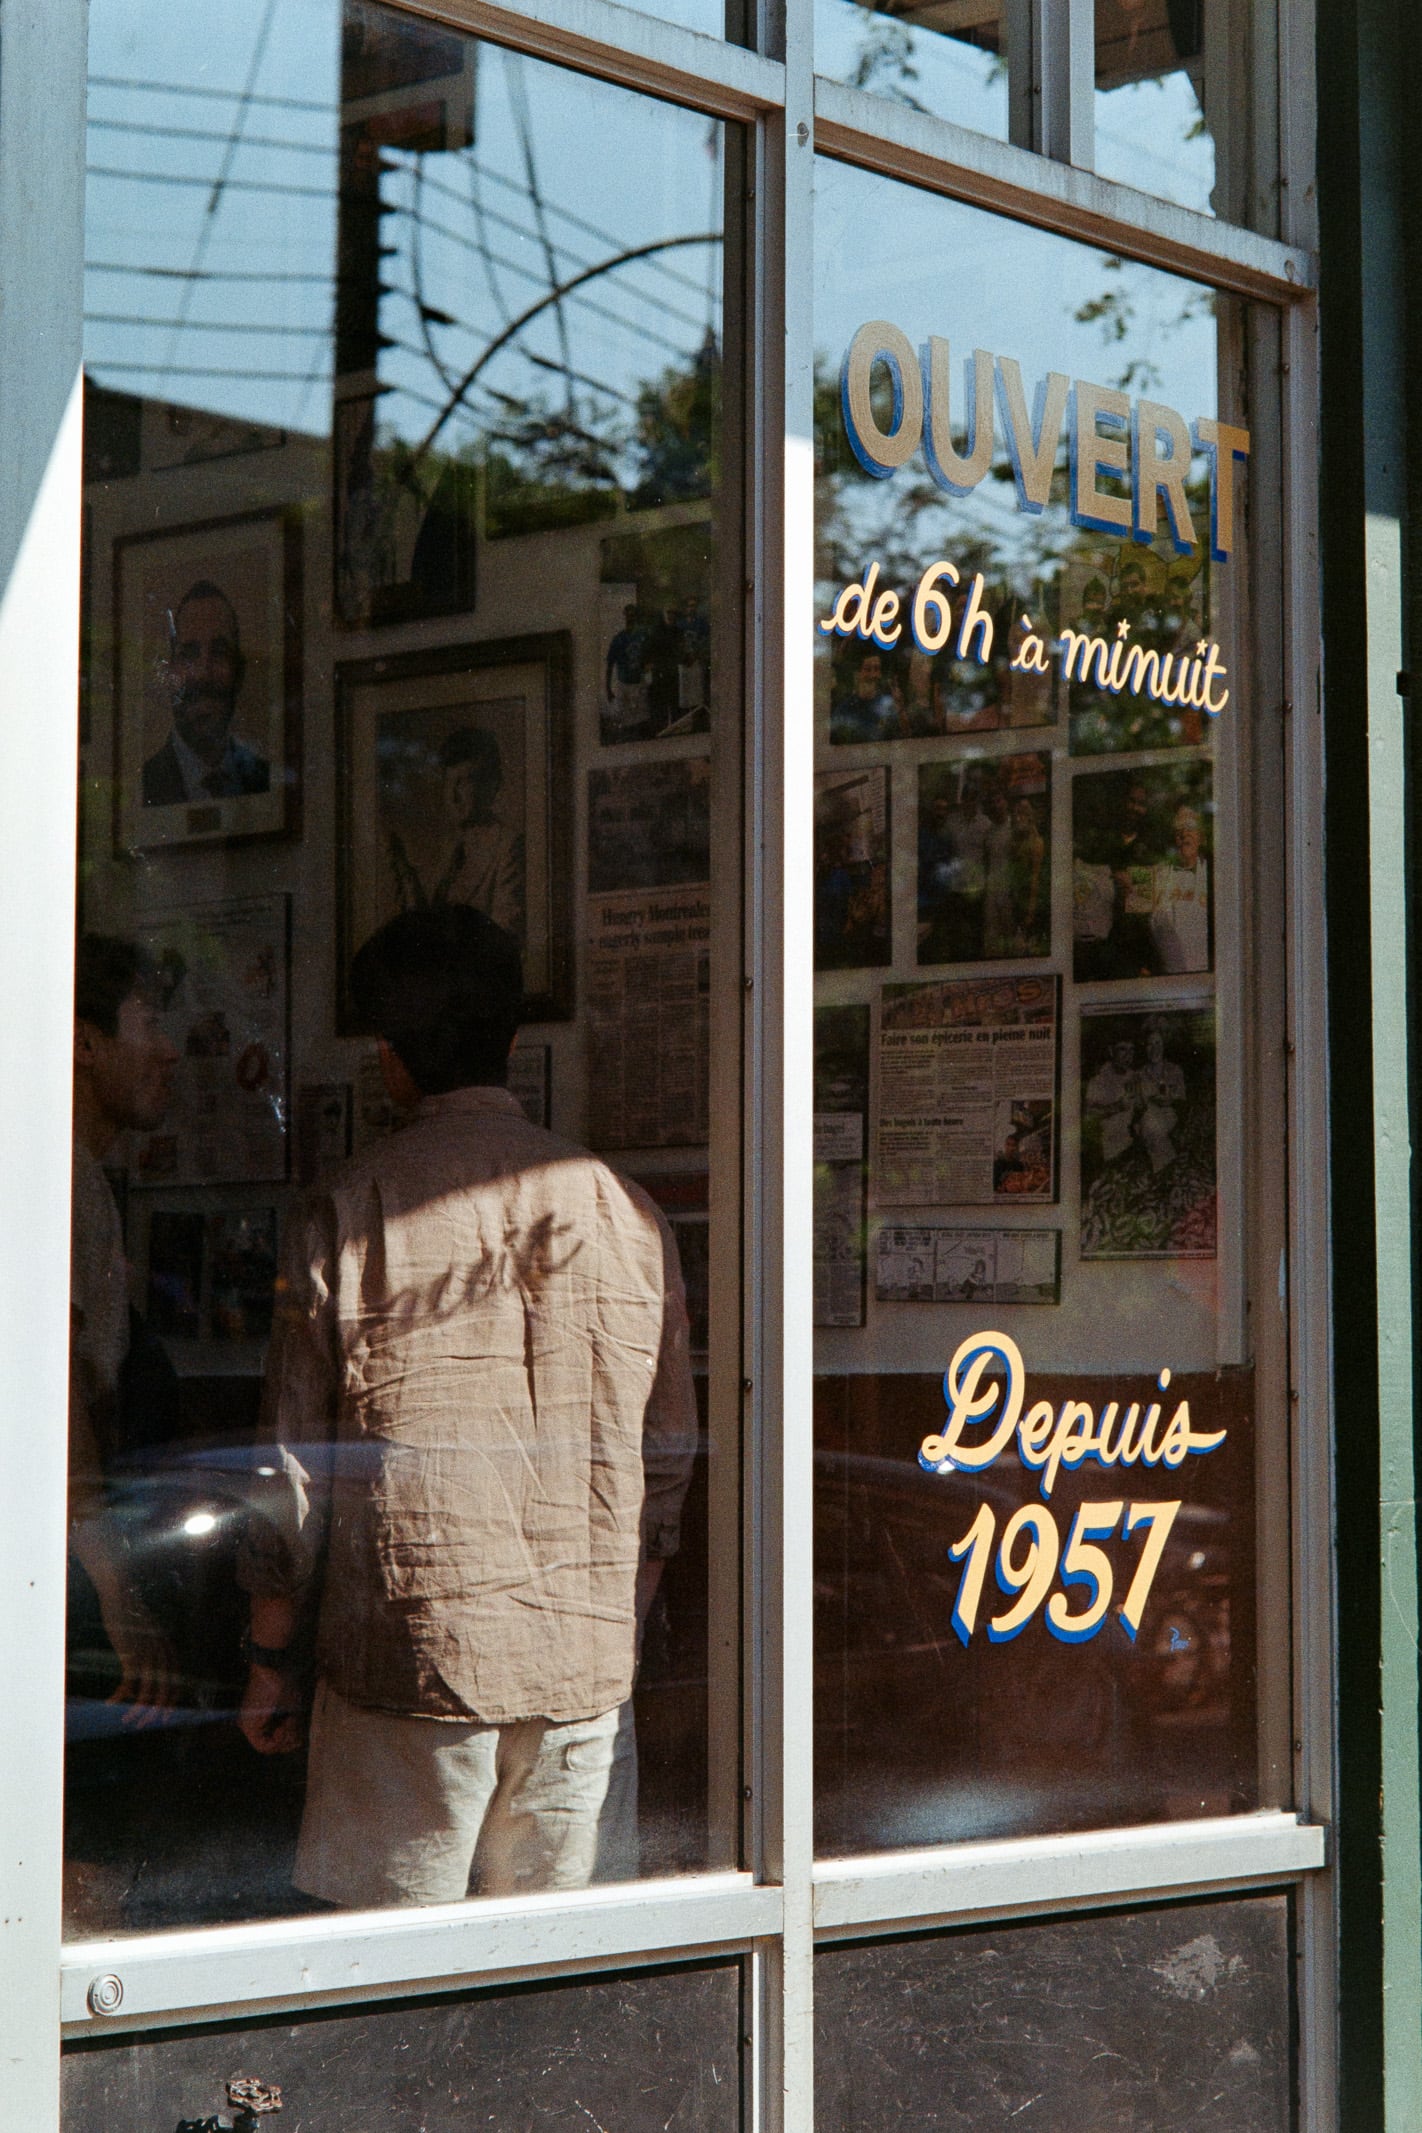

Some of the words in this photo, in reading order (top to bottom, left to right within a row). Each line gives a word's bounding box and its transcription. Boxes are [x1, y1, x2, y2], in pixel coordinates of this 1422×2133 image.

[841, 320, 1250, 563] OUVERT
[818, 561, 902, 651] de
[1010, 614, 1049, 675] à
[1060, 617, 1229, 716] minuit
[881, 1033, 907, 1046] Faire
[910, 1033, 928, 1045] son
[932, 1030, 973, 1047] épicerie
[976, 1030, 989, 1043] en
[1028, 1026, 1051, 1041] nuit
[918, 1330, 1227, 1500] Depuis
[948, 1500, 1182, 1647] 1957
